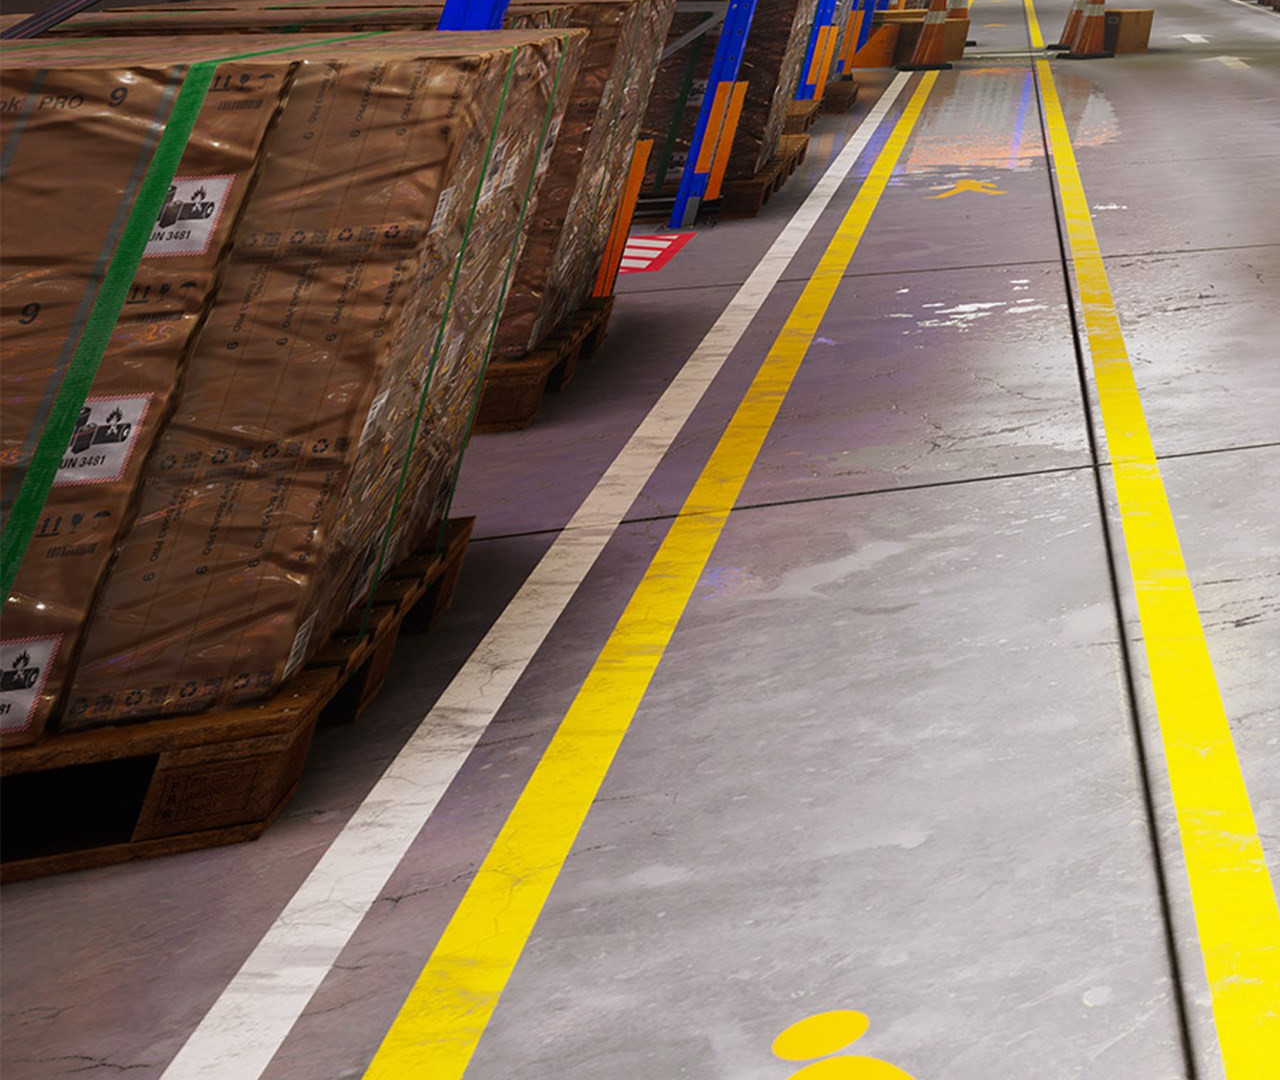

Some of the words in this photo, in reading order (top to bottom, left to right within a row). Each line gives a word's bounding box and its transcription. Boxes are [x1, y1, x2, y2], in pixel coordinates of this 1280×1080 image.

[38, 94, 85, 111] PRO
[107, 86, 129, 108] 9
[165, 229, 192, 241] 3481
[18, 302, 42, 325] 9
[78, 455, 106, 468] 3481
[0, 704, 11, 715] 81
